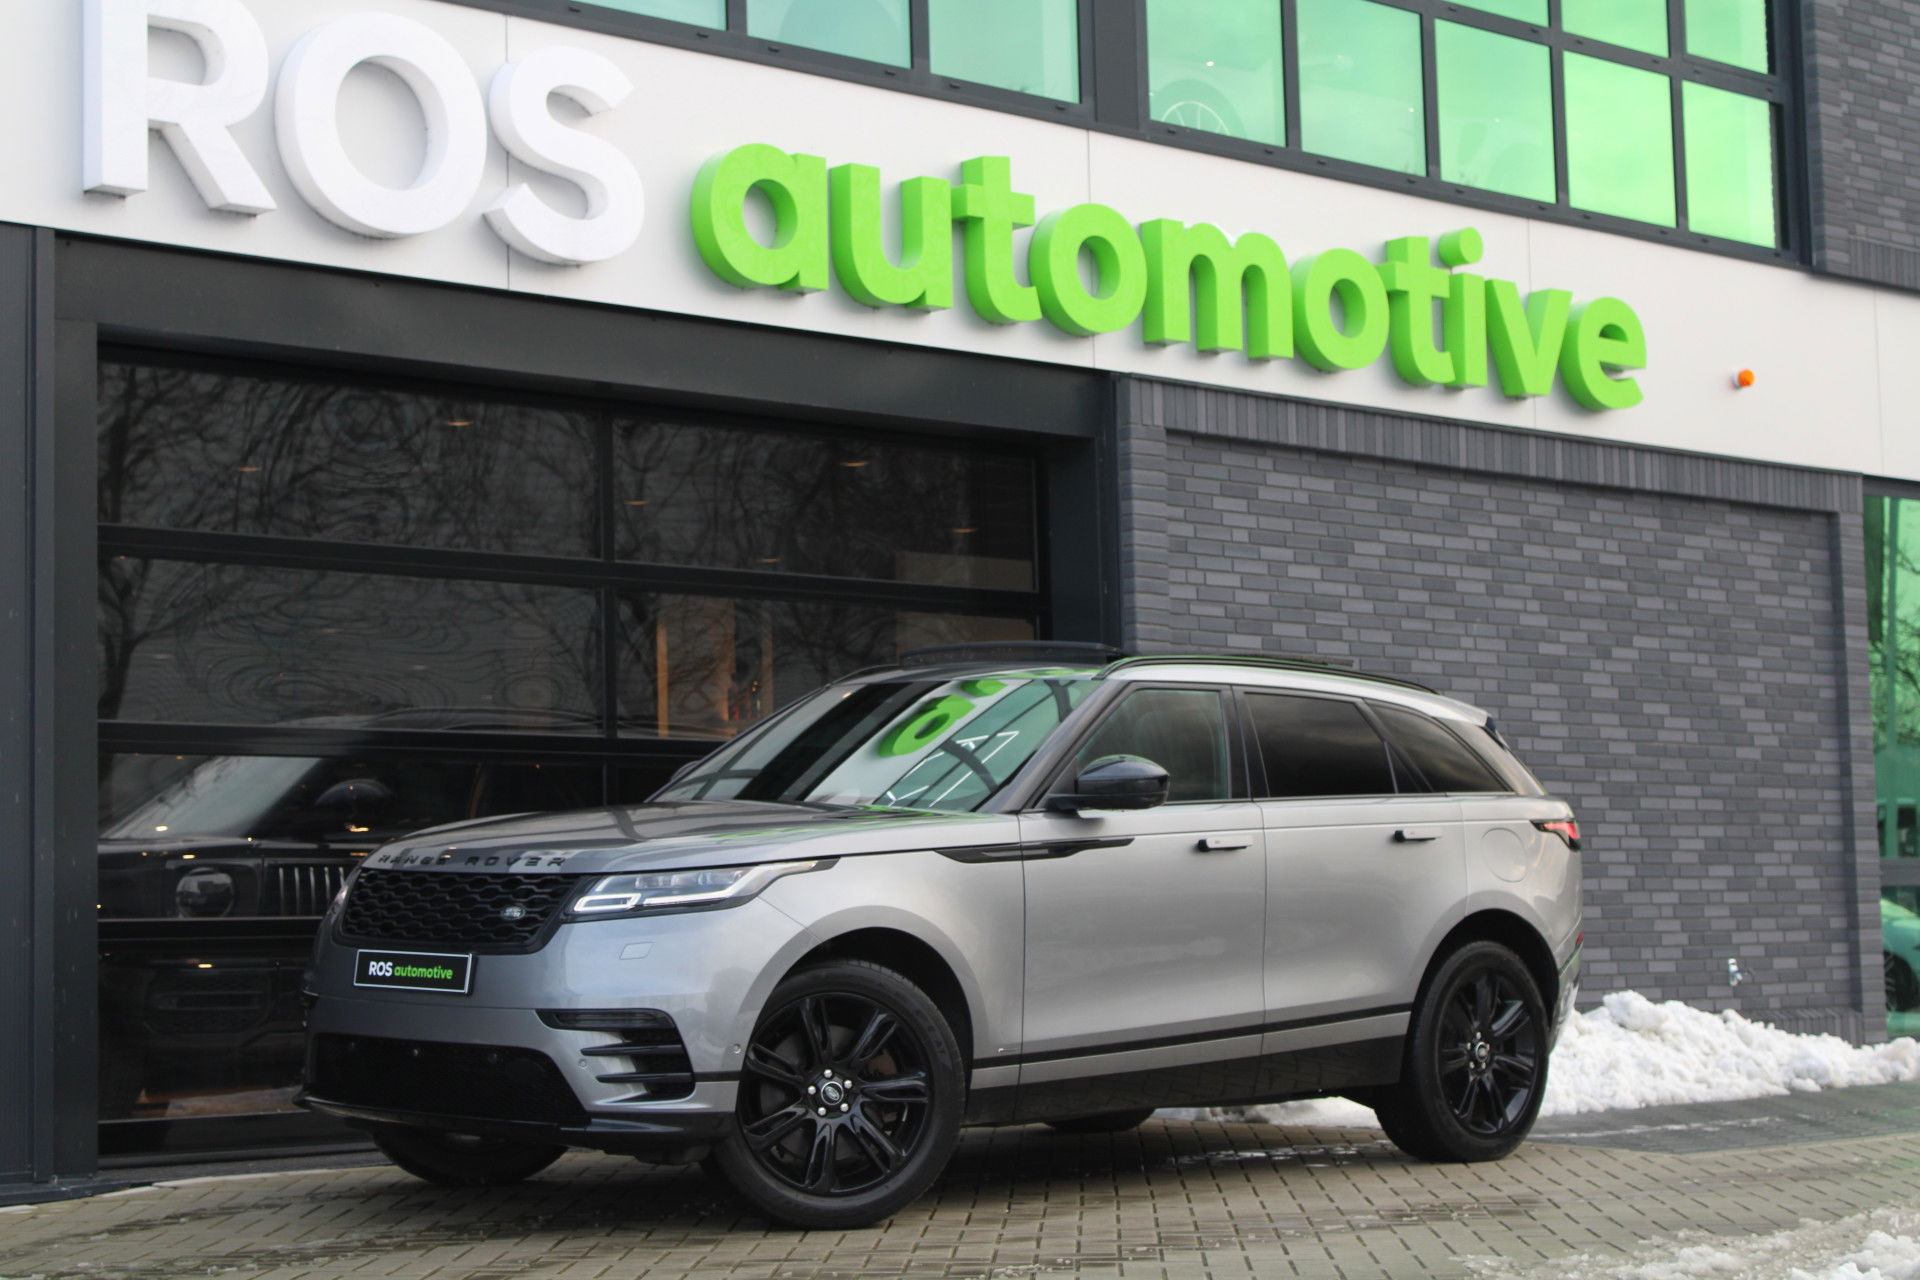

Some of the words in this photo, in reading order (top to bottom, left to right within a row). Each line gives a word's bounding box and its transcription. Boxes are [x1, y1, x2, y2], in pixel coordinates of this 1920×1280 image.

[82, 0, 646, 265] ROS
[691, 143, 1647, 409] automotive
[378, 854, 450, 866] RANGE
[464, 855, 566, 867] ROVER
[368, 961, 393, 977] ROS
[394, 965, 453, 980] automotive
